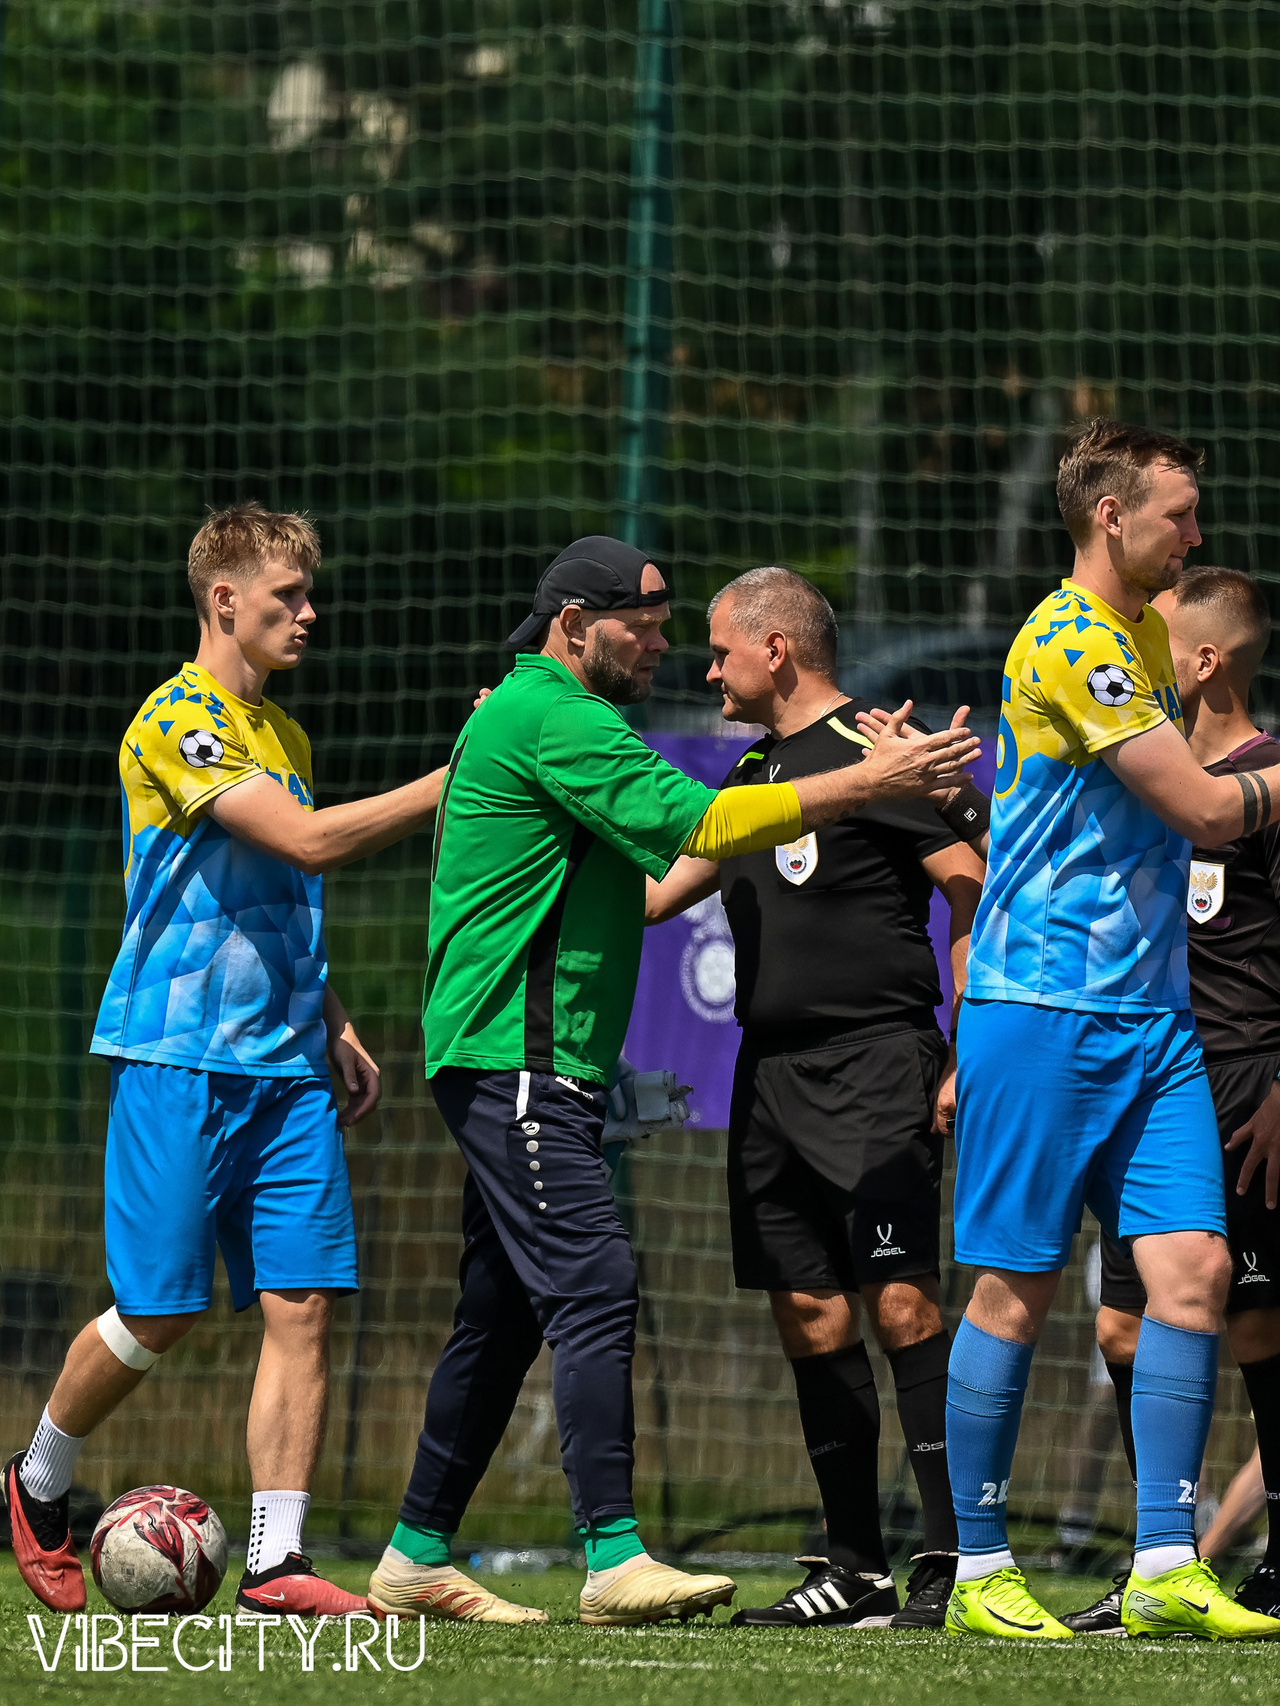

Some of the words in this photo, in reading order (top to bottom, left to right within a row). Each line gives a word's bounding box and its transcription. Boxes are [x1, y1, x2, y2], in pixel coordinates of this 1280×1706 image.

[870, 1247, 906, 1258] JÖGEL
[1237, 1274, 1271, 1285] JÖGEL
[912, 1441, 947, 1453] JÖG
